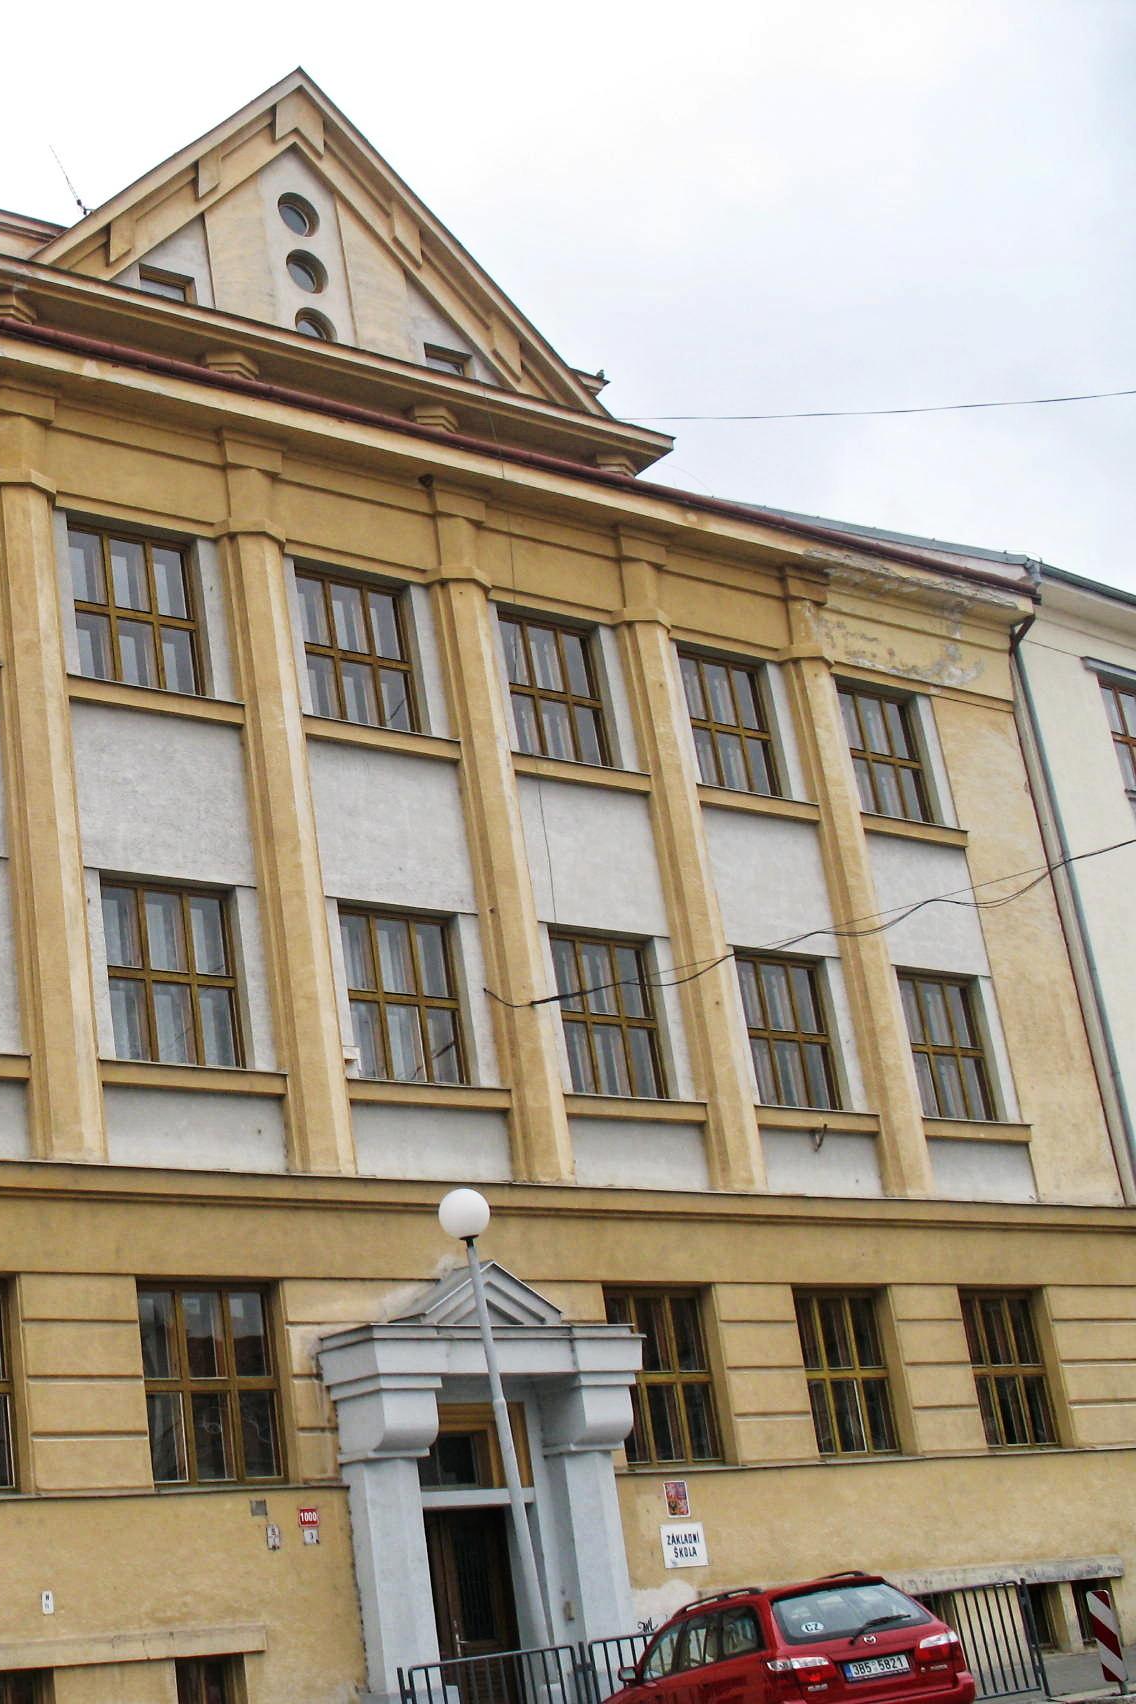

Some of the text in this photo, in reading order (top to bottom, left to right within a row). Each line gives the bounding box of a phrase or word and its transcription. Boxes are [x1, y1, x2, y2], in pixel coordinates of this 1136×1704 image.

[300, 1512, 317, 1522] 1000
[666, 1531, 700, 1546] ZÁKLADNÍ
[673, 1546, 698, 1558] ŠKOLA
[852, 1656, 904, 1676] 3B5 5821
